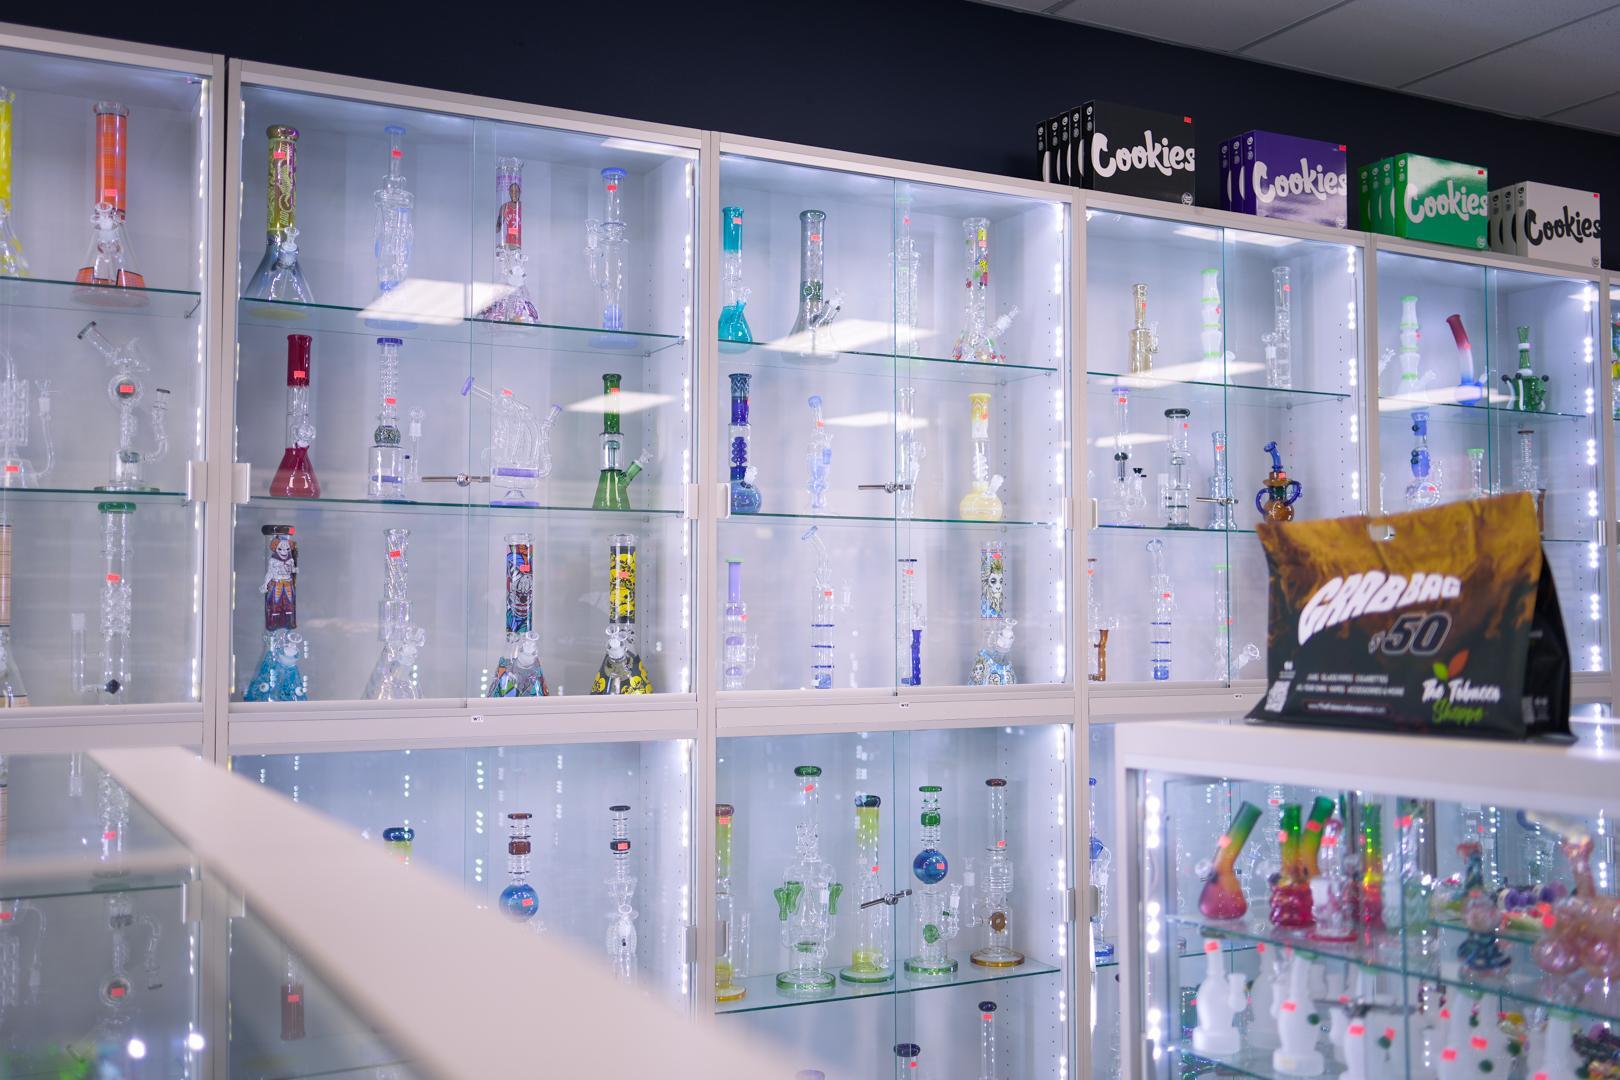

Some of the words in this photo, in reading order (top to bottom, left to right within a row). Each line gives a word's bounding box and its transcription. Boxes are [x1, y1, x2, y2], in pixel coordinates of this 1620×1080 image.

[1091, 130, 1195, 178] Cookies
[1252, 158, 1347, 204] Cookies
[1404, 180, 1487, 224] Cookies
[1524, 205, 1601, 246] Cookies
[1381, 611, 1453, 655] 50
